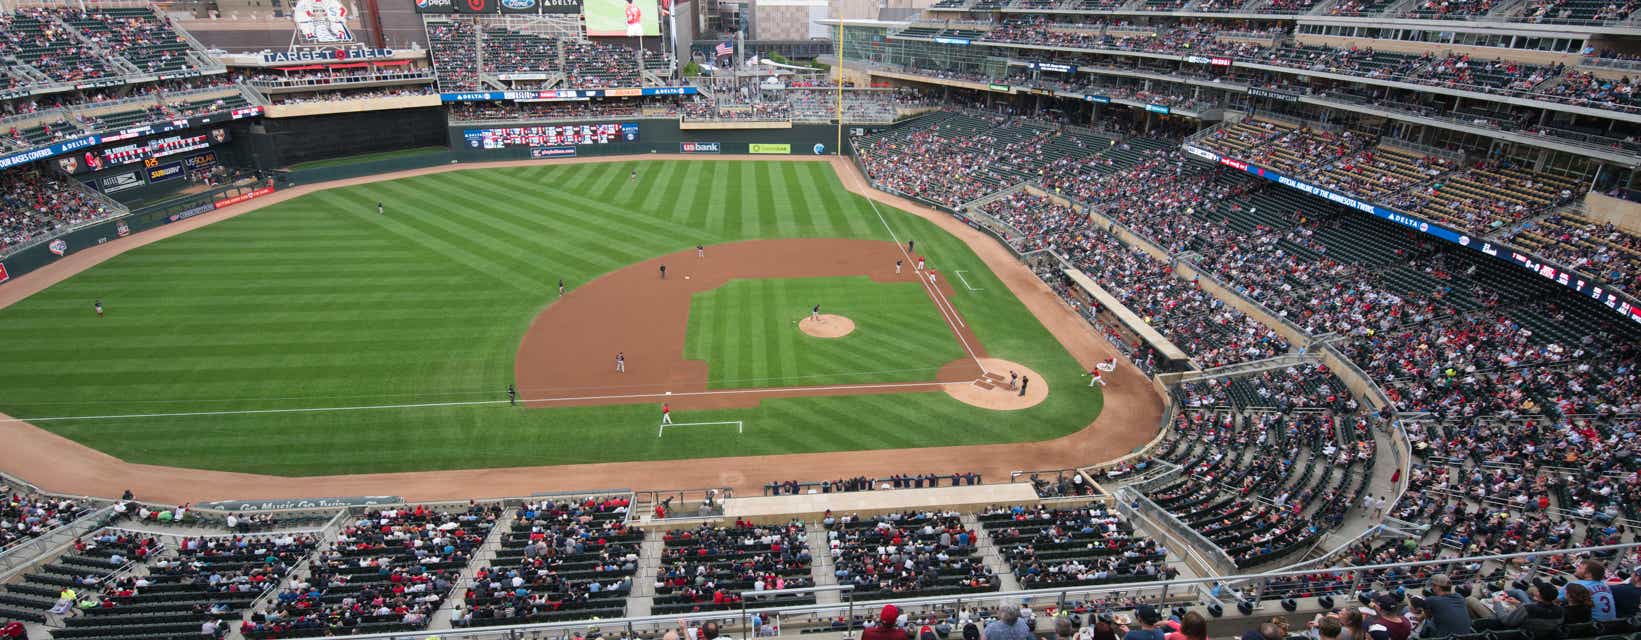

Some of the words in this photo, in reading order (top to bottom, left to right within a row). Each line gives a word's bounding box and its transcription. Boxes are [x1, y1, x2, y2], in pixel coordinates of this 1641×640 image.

[265, 50, 332, 62] TARGET
[350, 48, 394, 59] FIELD
[1253, 89, 1267, 97] DELTA
[68, 140, 87, 149] DELTA
[11, 154, 28, 165] BASES
[151, 166, 180, 179] SUBWAY
[1278, 176, 1296, 188] OFFICIAL
[1296, 181, 1312, 193] AIRLINE
[1312, 187, 1320, 195] OF
[1320, 189, 1329, 199] THE
[1329, 192, 1356, 207] MINNESOTA
[1396, 215, 1419, 228] DELTA
[240, 503, 258, 511] Go
[298, 500, 315, 508] Go
[1599, 596, 1610, 613] 3
